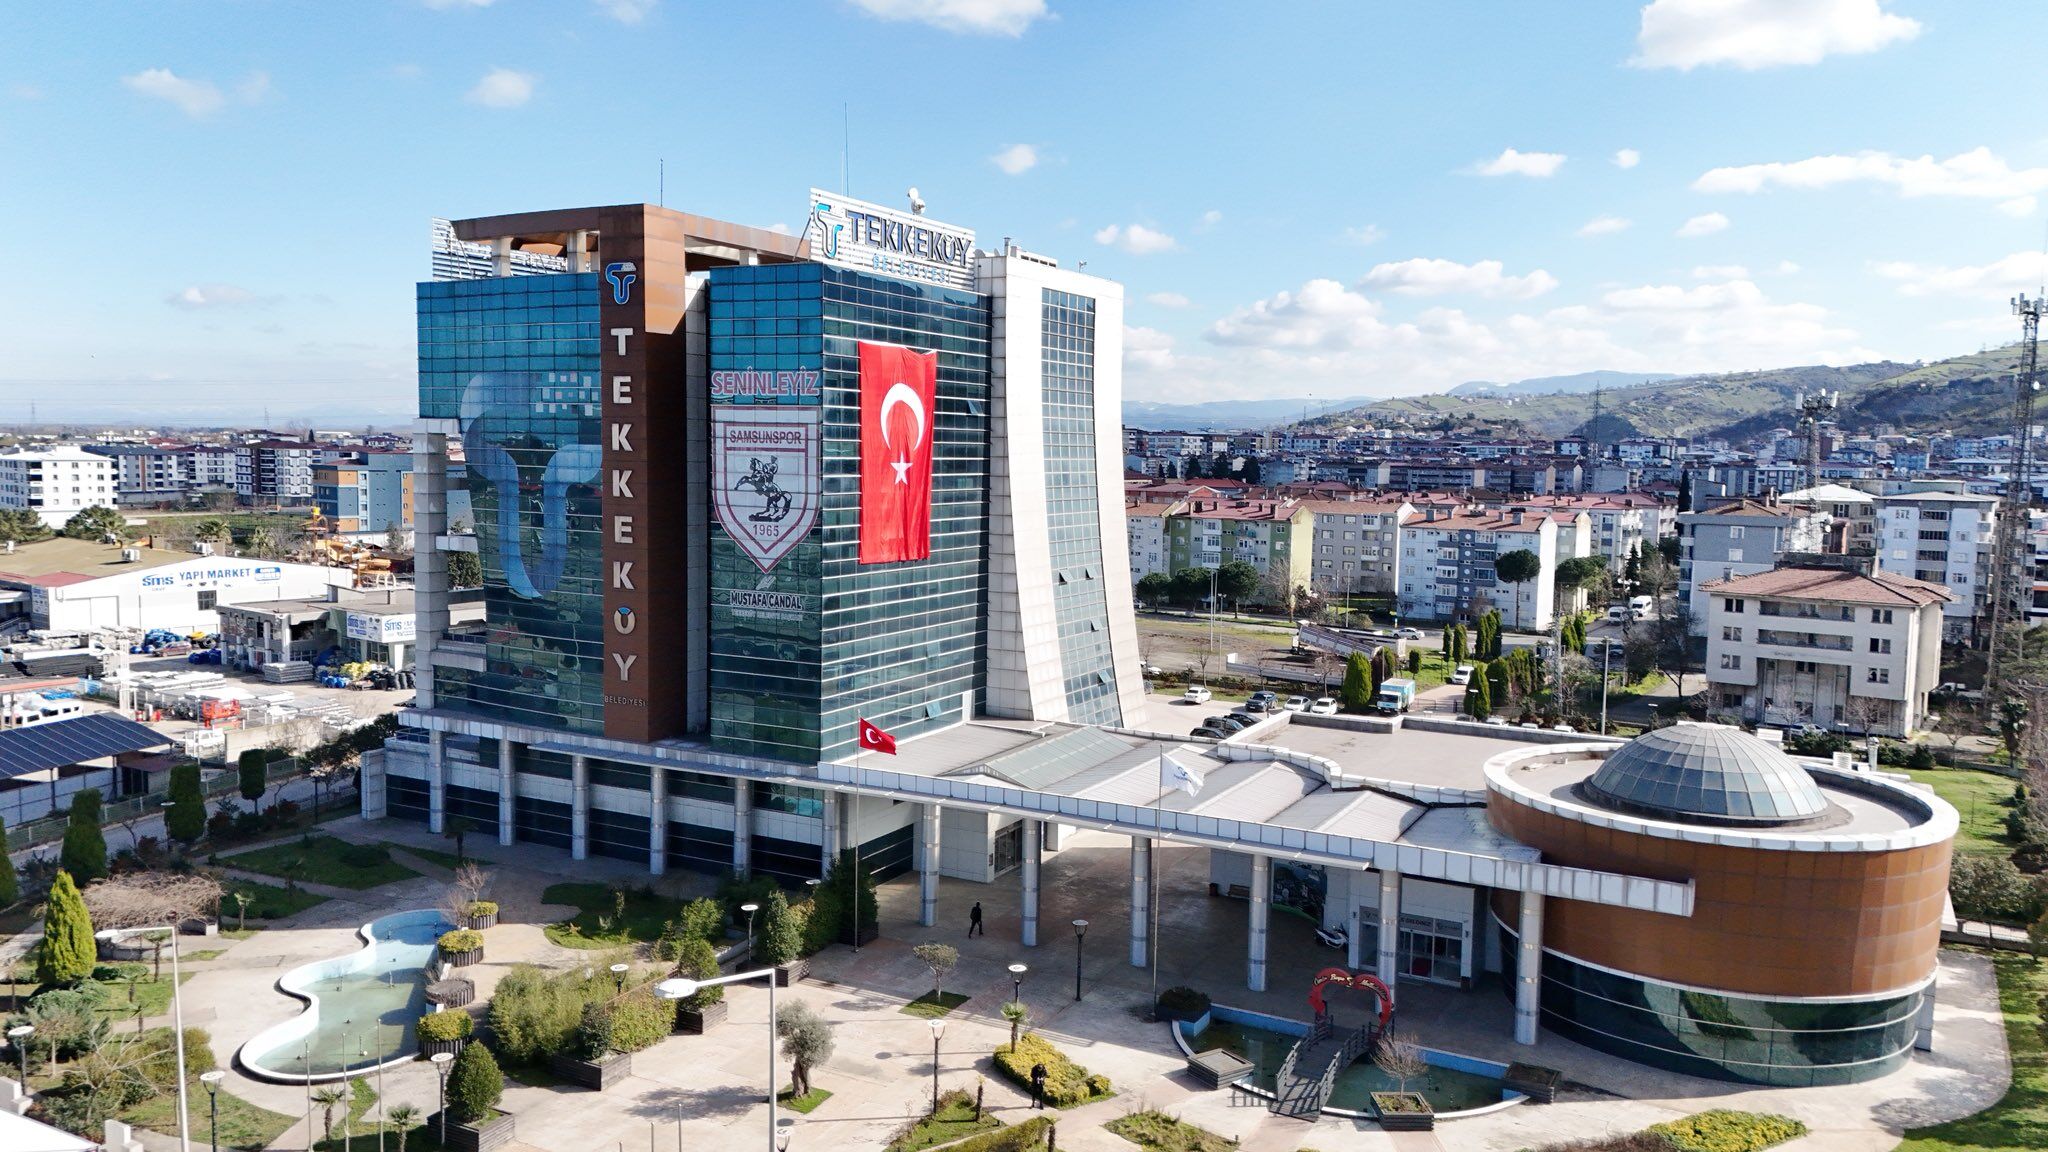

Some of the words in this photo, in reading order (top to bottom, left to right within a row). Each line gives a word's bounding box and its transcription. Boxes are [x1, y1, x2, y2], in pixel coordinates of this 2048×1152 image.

[711, 366, 819, 396] SENİNLEYİZ
[729, 430, 802, 445] SAMSUNSPOR
[753, 524, 779, 537] 1965
[179, 571, 204, 581] YAPI
[207, 568, 251, 579] MARKET
[730, 591, 768, 607] MUSTAFA
[769, 595, 803, 610] CANDAL
